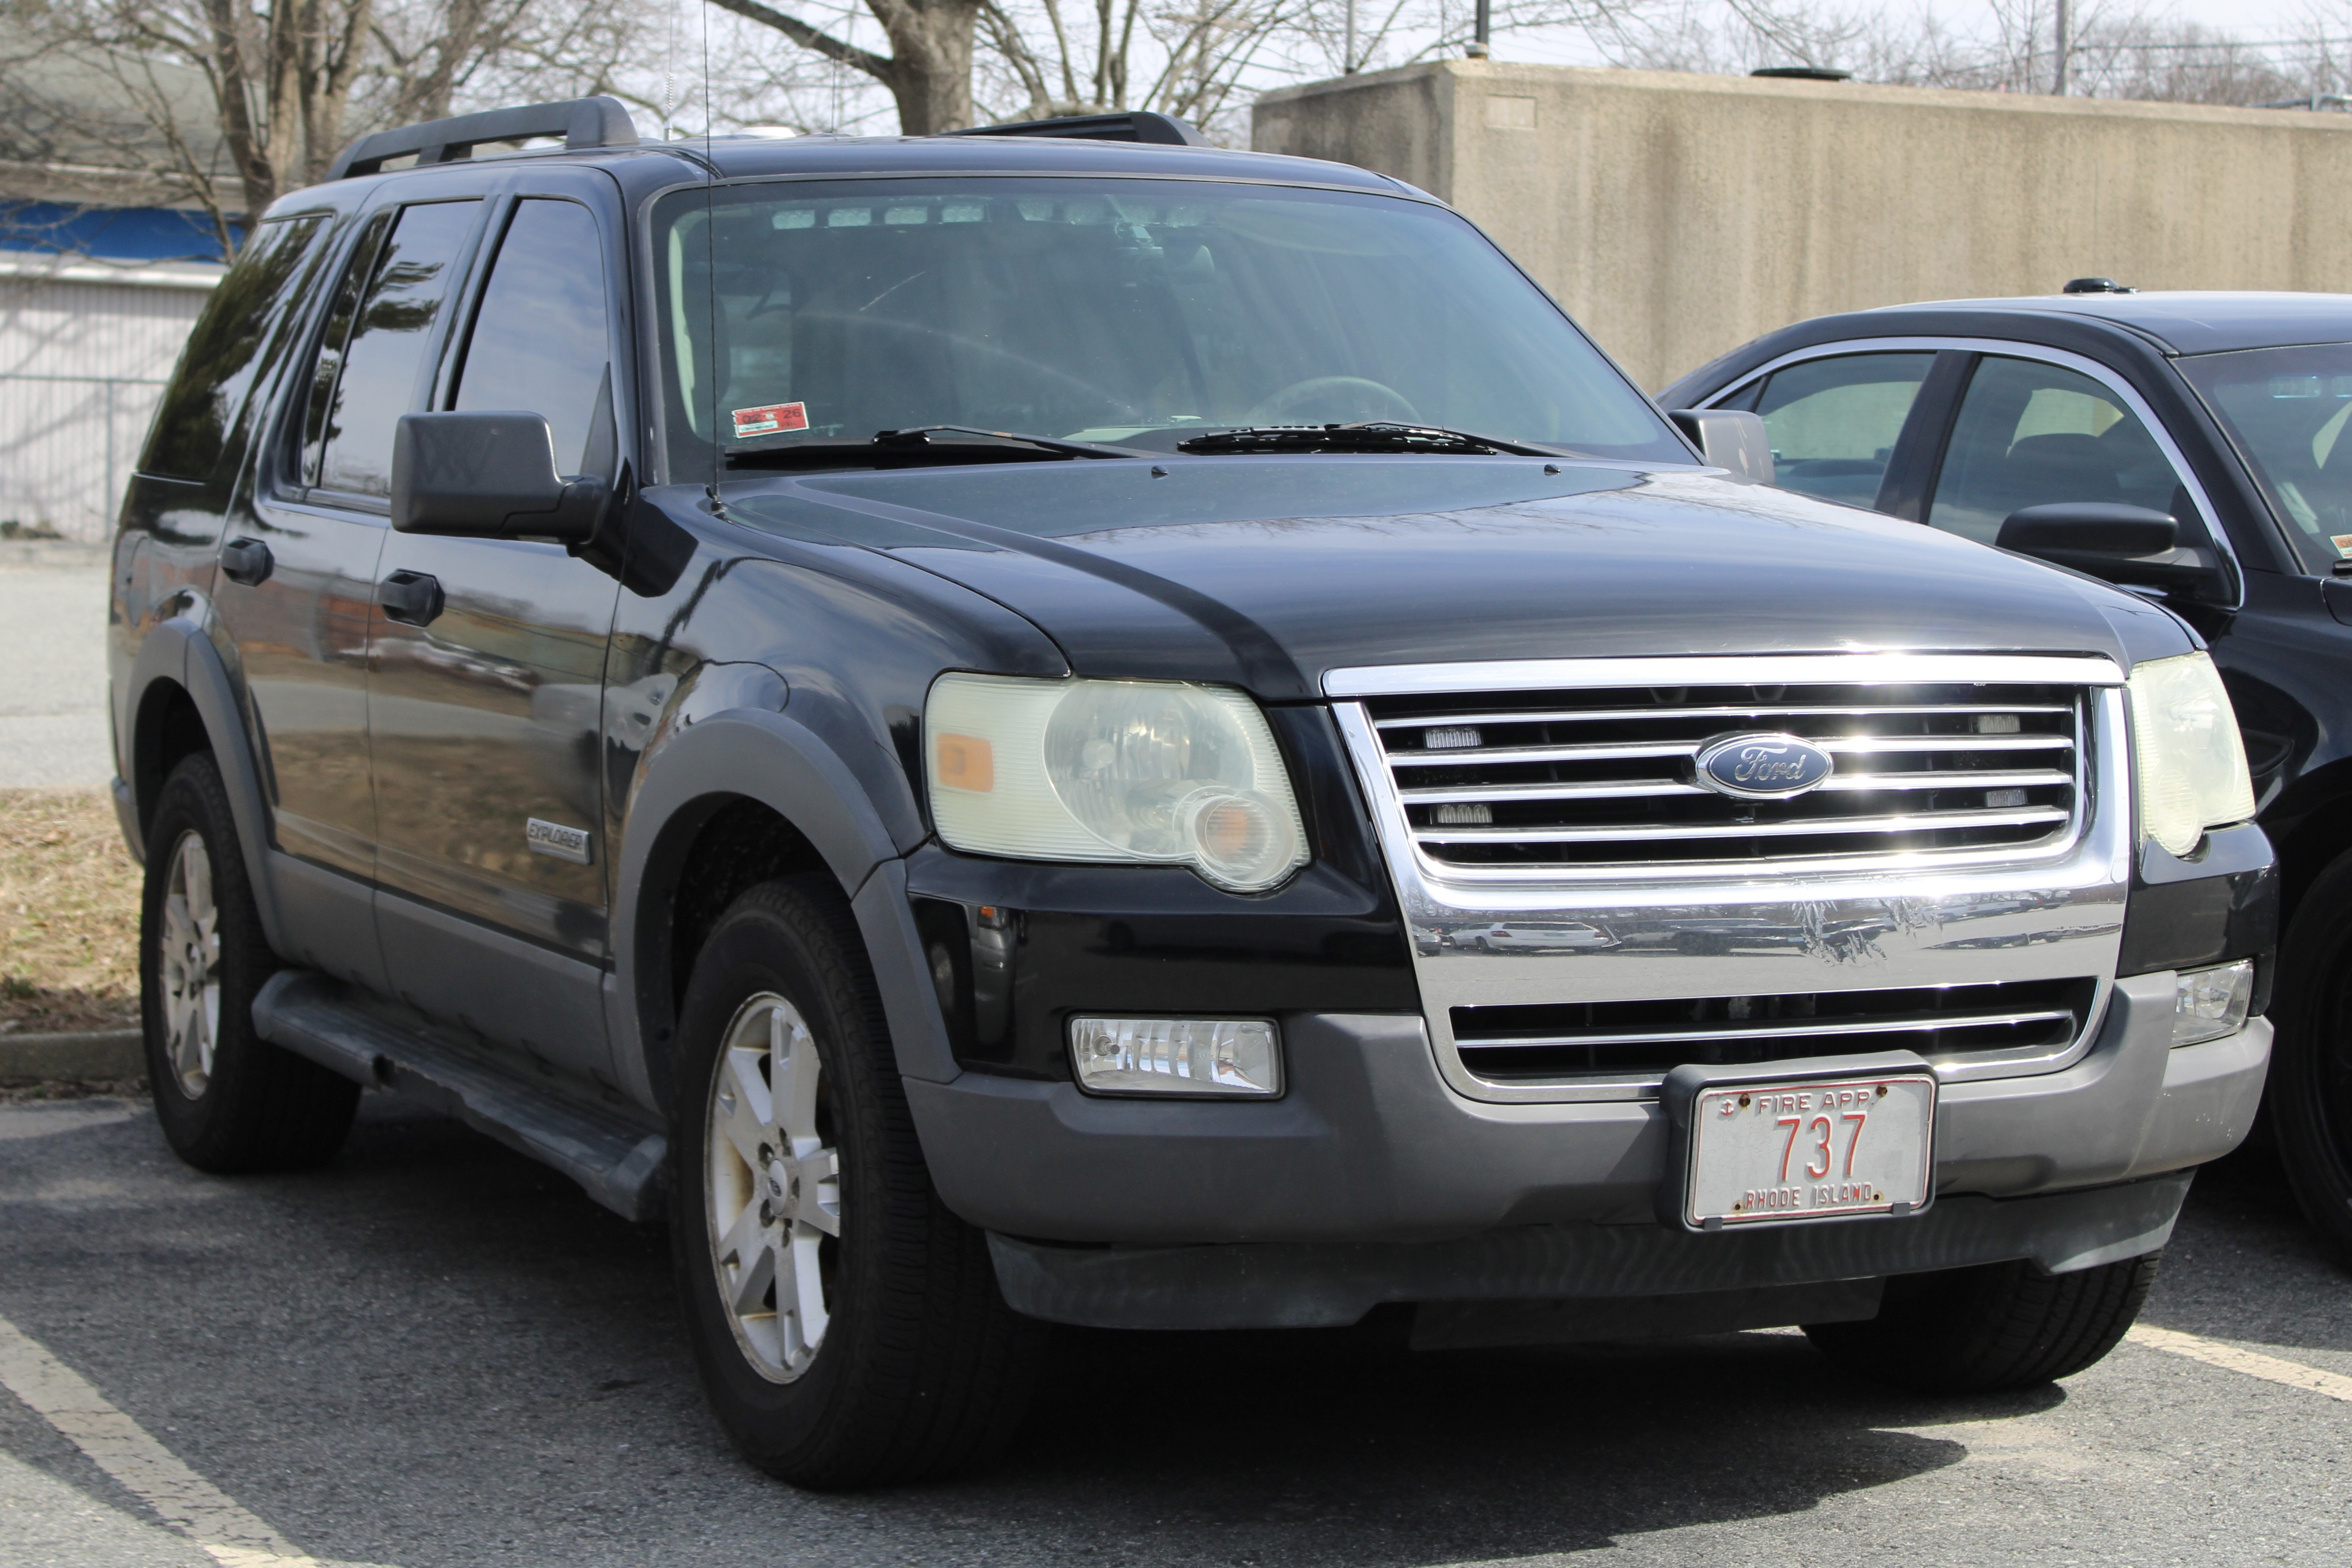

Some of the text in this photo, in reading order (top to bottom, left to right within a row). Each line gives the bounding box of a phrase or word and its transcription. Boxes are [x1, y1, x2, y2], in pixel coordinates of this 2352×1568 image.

[783, 409, 802, 419] 26
[1735, 746, 1807, 782] Ford
[1759, 1093, 1812, 1113] FIRE
[1777, 1111, 1867, 1181] 737
[1746, 1181, 1873, 1209] RHODE ISLAND
